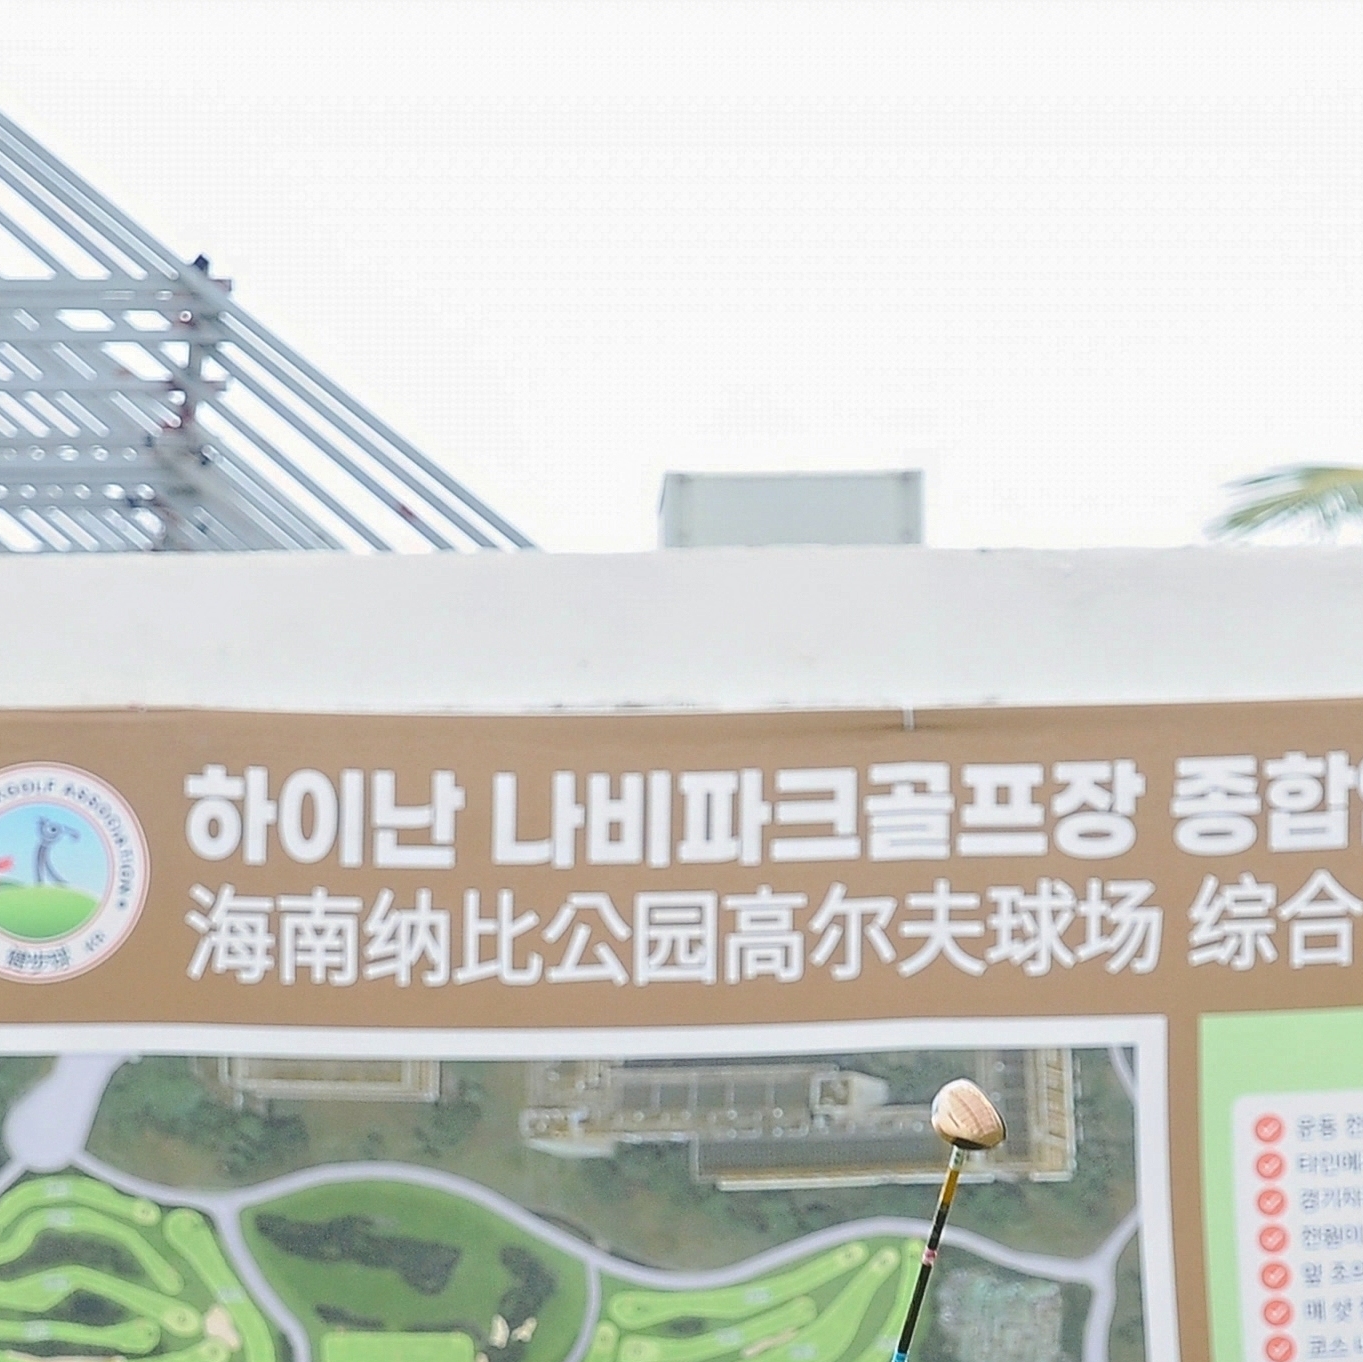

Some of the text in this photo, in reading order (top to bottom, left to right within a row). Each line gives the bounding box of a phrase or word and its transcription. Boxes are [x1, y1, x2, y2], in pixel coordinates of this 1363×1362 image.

[185, 764, 465, 869] 하이난
[491, 760, 1147, 870] 나비파크골프장
[184, 875, 1163, 988] 海南纳比公园高尔夫球场
